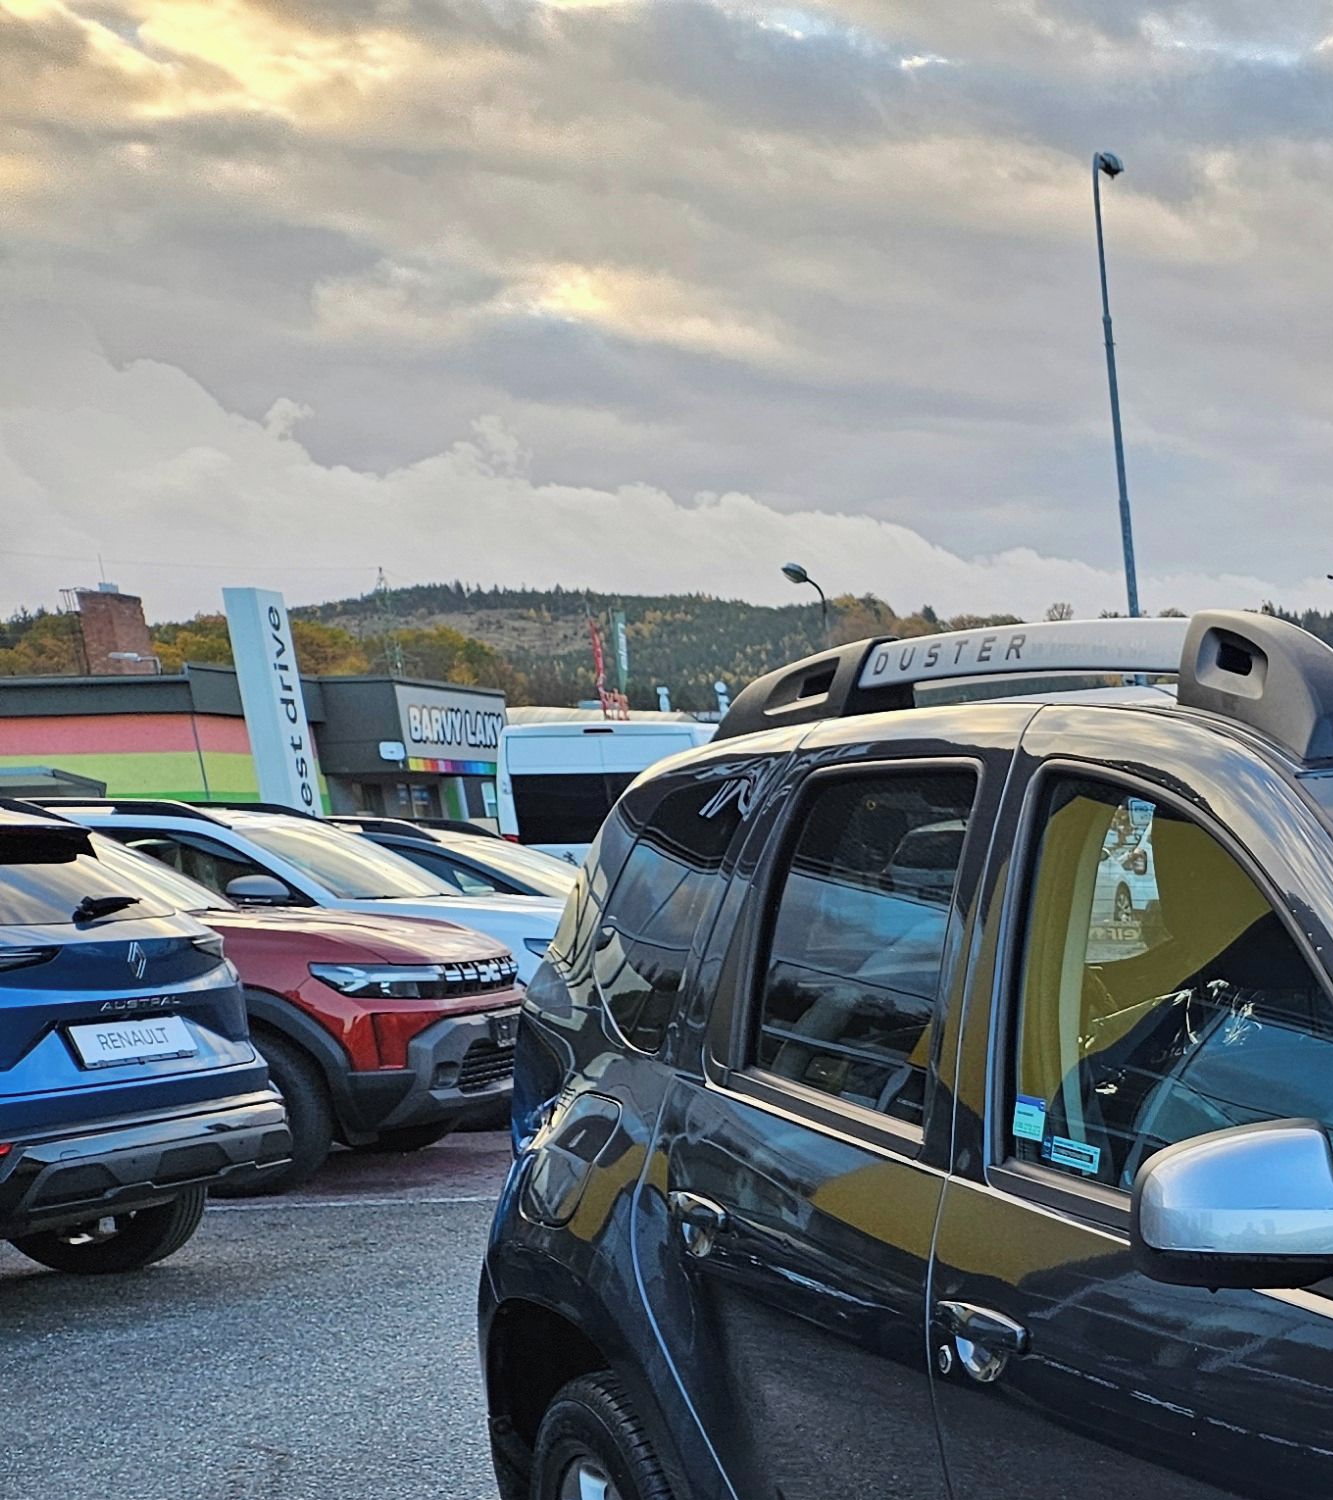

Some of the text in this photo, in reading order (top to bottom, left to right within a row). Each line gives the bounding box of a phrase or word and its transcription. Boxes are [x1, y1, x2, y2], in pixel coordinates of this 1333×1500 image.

[873, 634, 1026, 675] DUSTER
[268, 606, 315, 817] est drive
[408, 704, 503, 748] BARVY LAKY
[100, 996, 180, 1012] AUSTRAL
[96, 1027, 169, 1050] RENAULT
